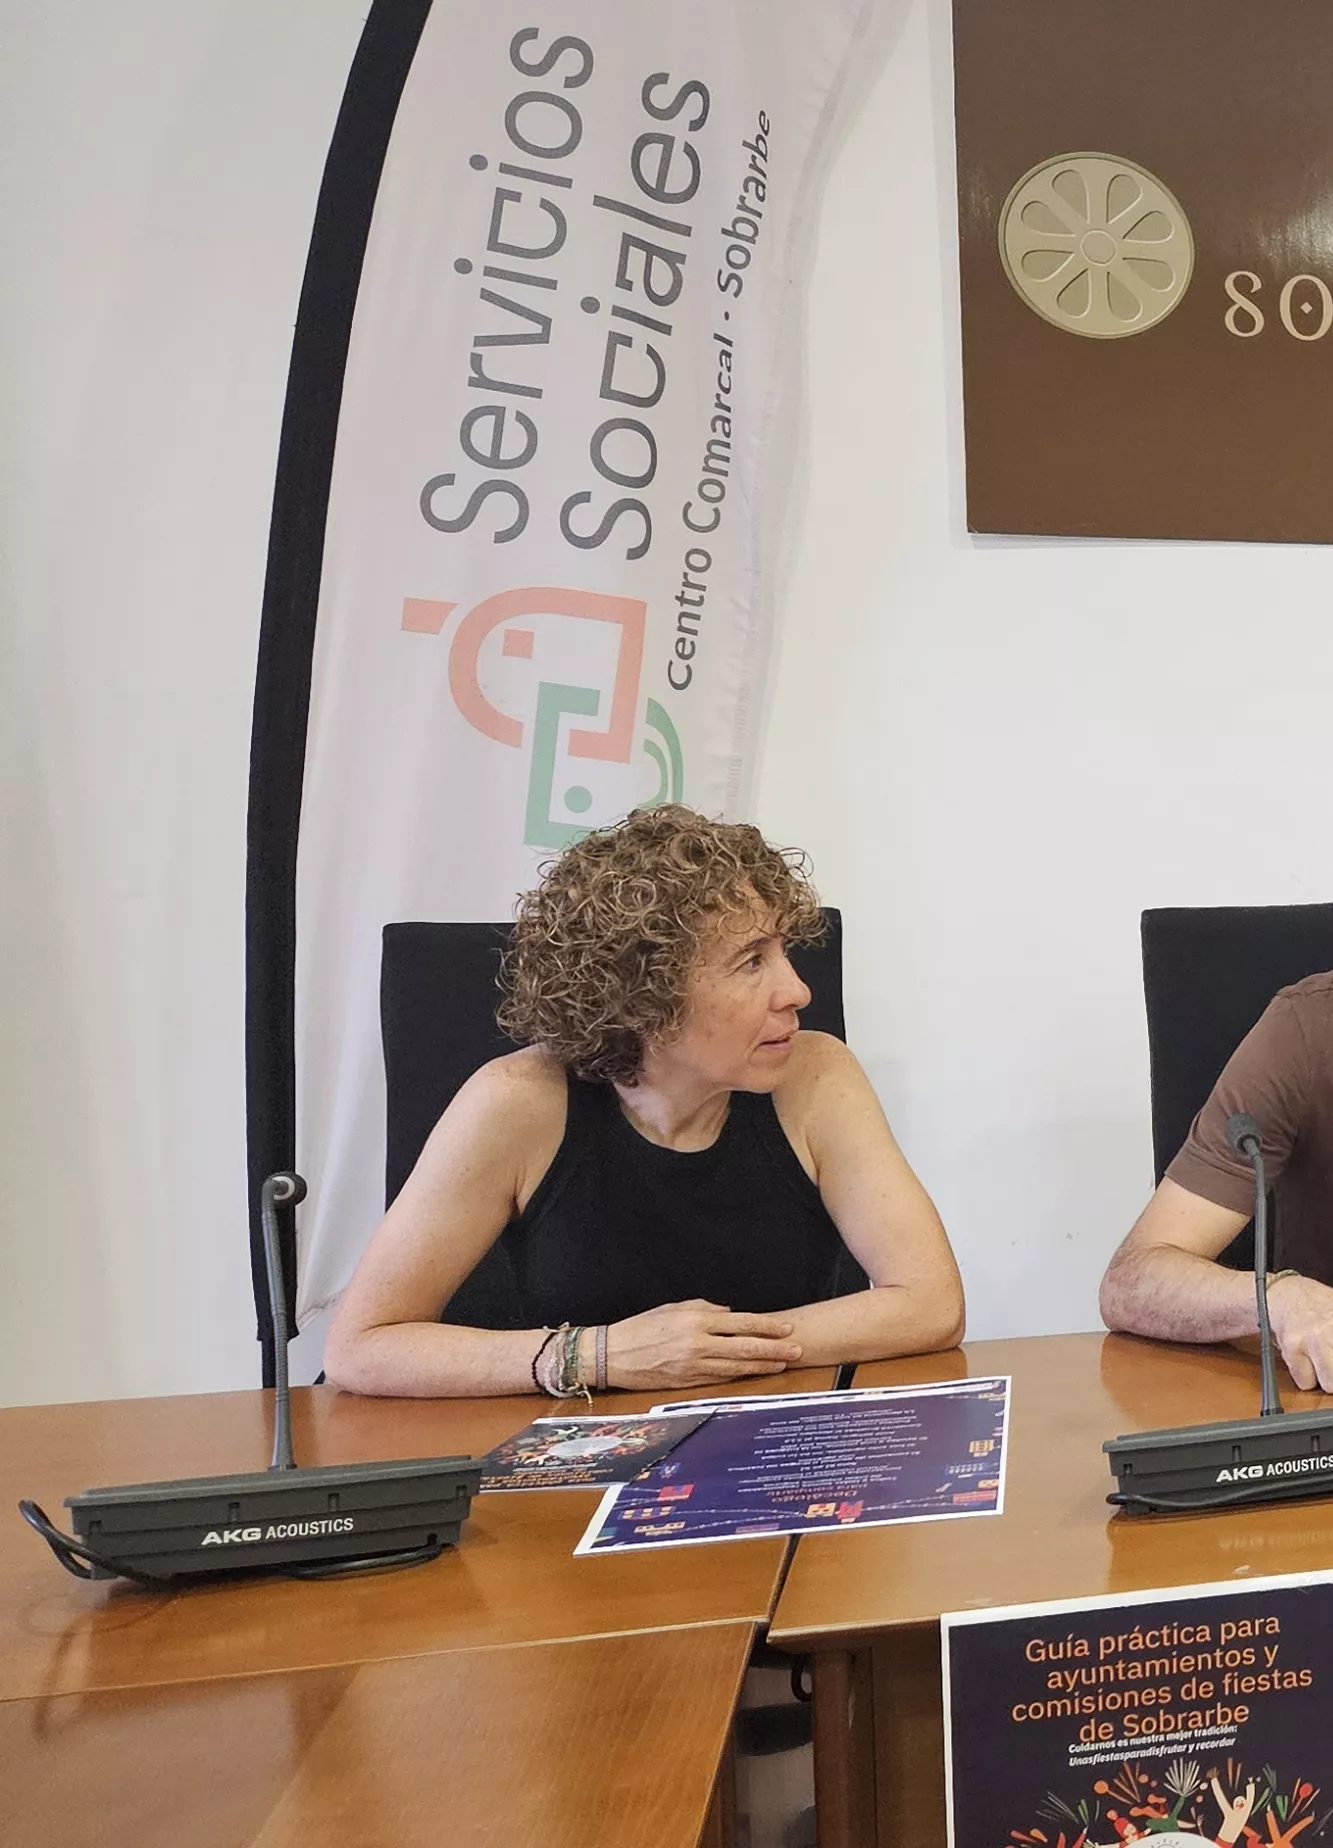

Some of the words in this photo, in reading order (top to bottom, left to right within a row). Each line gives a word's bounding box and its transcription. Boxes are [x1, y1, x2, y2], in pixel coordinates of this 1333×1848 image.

[716, 109, 771, 298] Sobrarbe
[420, 26, 594, 545] Servicios
[559, 71, 712, 561] Sociales
[683, 332, 735, 533] Comarcal
[667, 534, 714, 692] Centro
[1216, 1463, 1264, 1484] AKG
[201, 1527, 262, 1545] AKG
[266, 1517, 354, 1540] ACOUSTICS
[1025, 1633, 1090, 1663] Guía
[1099, 1621, 1211, 1660] práctica
[1219, 1614, 1281, 1642] para
[1047, 1645, 1256, 1693] ayuntamientos
[1263, 1643, 1280, 1669] y
[1012, 1682, 1172, 1722] comisiones
[1180, 1676, 1214, 1702] de
[1222, 1666, 1313, 1697] fiestas
[1069, 1739, 1116, 1753] Cuidarnos
[1117, 1739, 1129, 1747] es
[1129, 1733, 1165, 1745] nuestra
[1166, 1731, 1192, 1742] mejor
[1079, 1717, 1113, 1743] de
[1123, 1700, 1250, 1738] Sobrarbe
[1195, 1737, 1236, 1751] recordar
